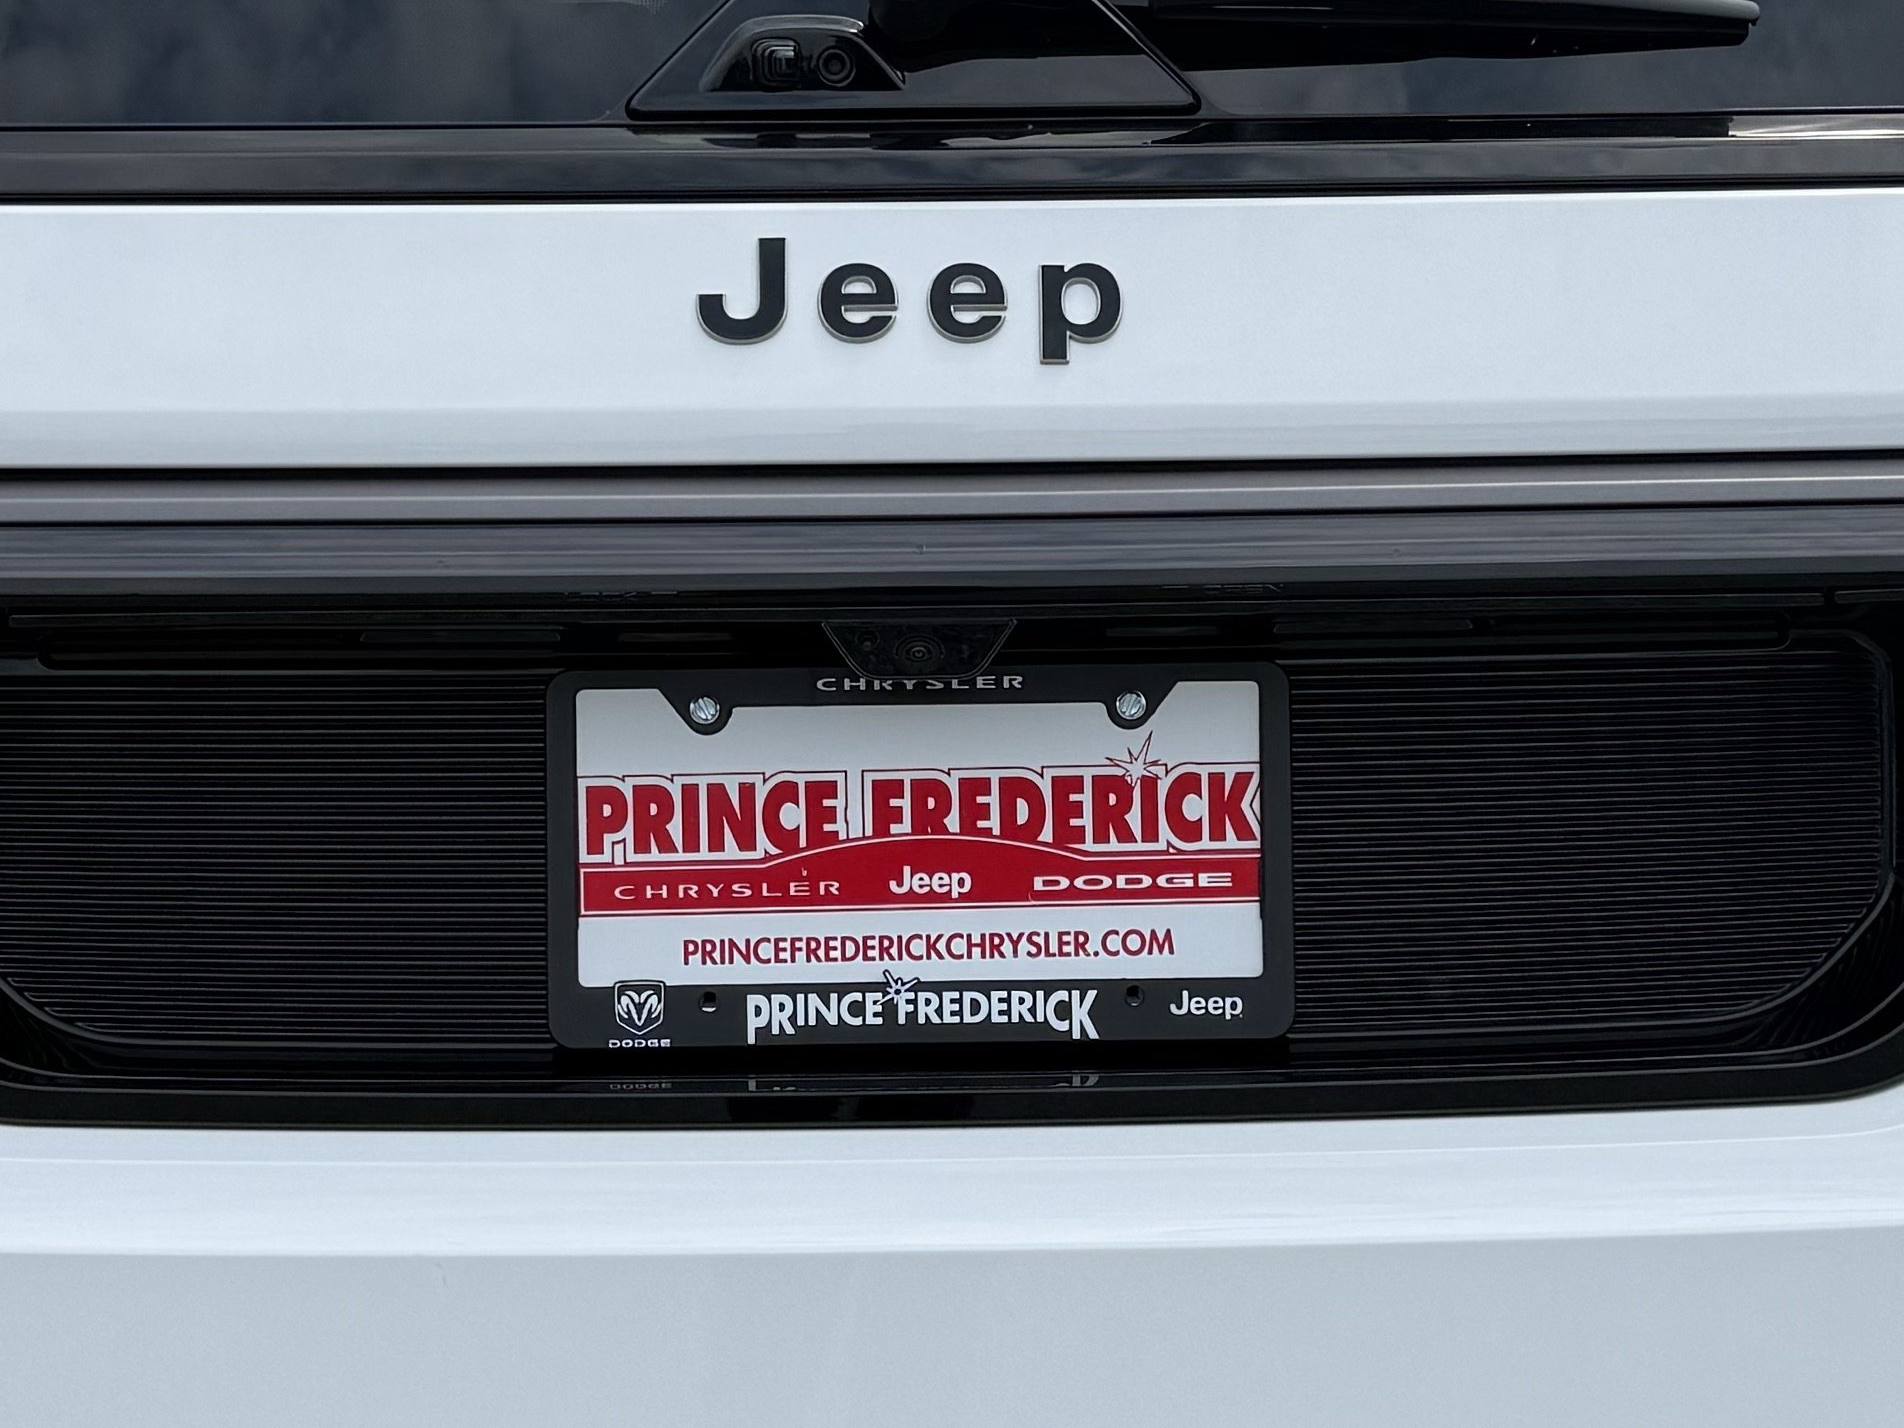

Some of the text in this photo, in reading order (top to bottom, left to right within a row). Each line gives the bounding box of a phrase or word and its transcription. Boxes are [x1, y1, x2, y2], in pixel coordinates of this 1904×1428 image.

[696, 236, 1124, 365] Jeep
[816, 675, 1024, 691] CHRYSLER
[585, 771, 1259, 856] PRINCE FREDERICK
[613, 865, 1234, 901] CHRYSLER Jeep DODGE
[683, 927, 1176, 967] PRINCEFREDERICKCHRYSLER.COM
[608, 988, 1244, 1049] DODGE PRINCE FREDERICK Jeep
